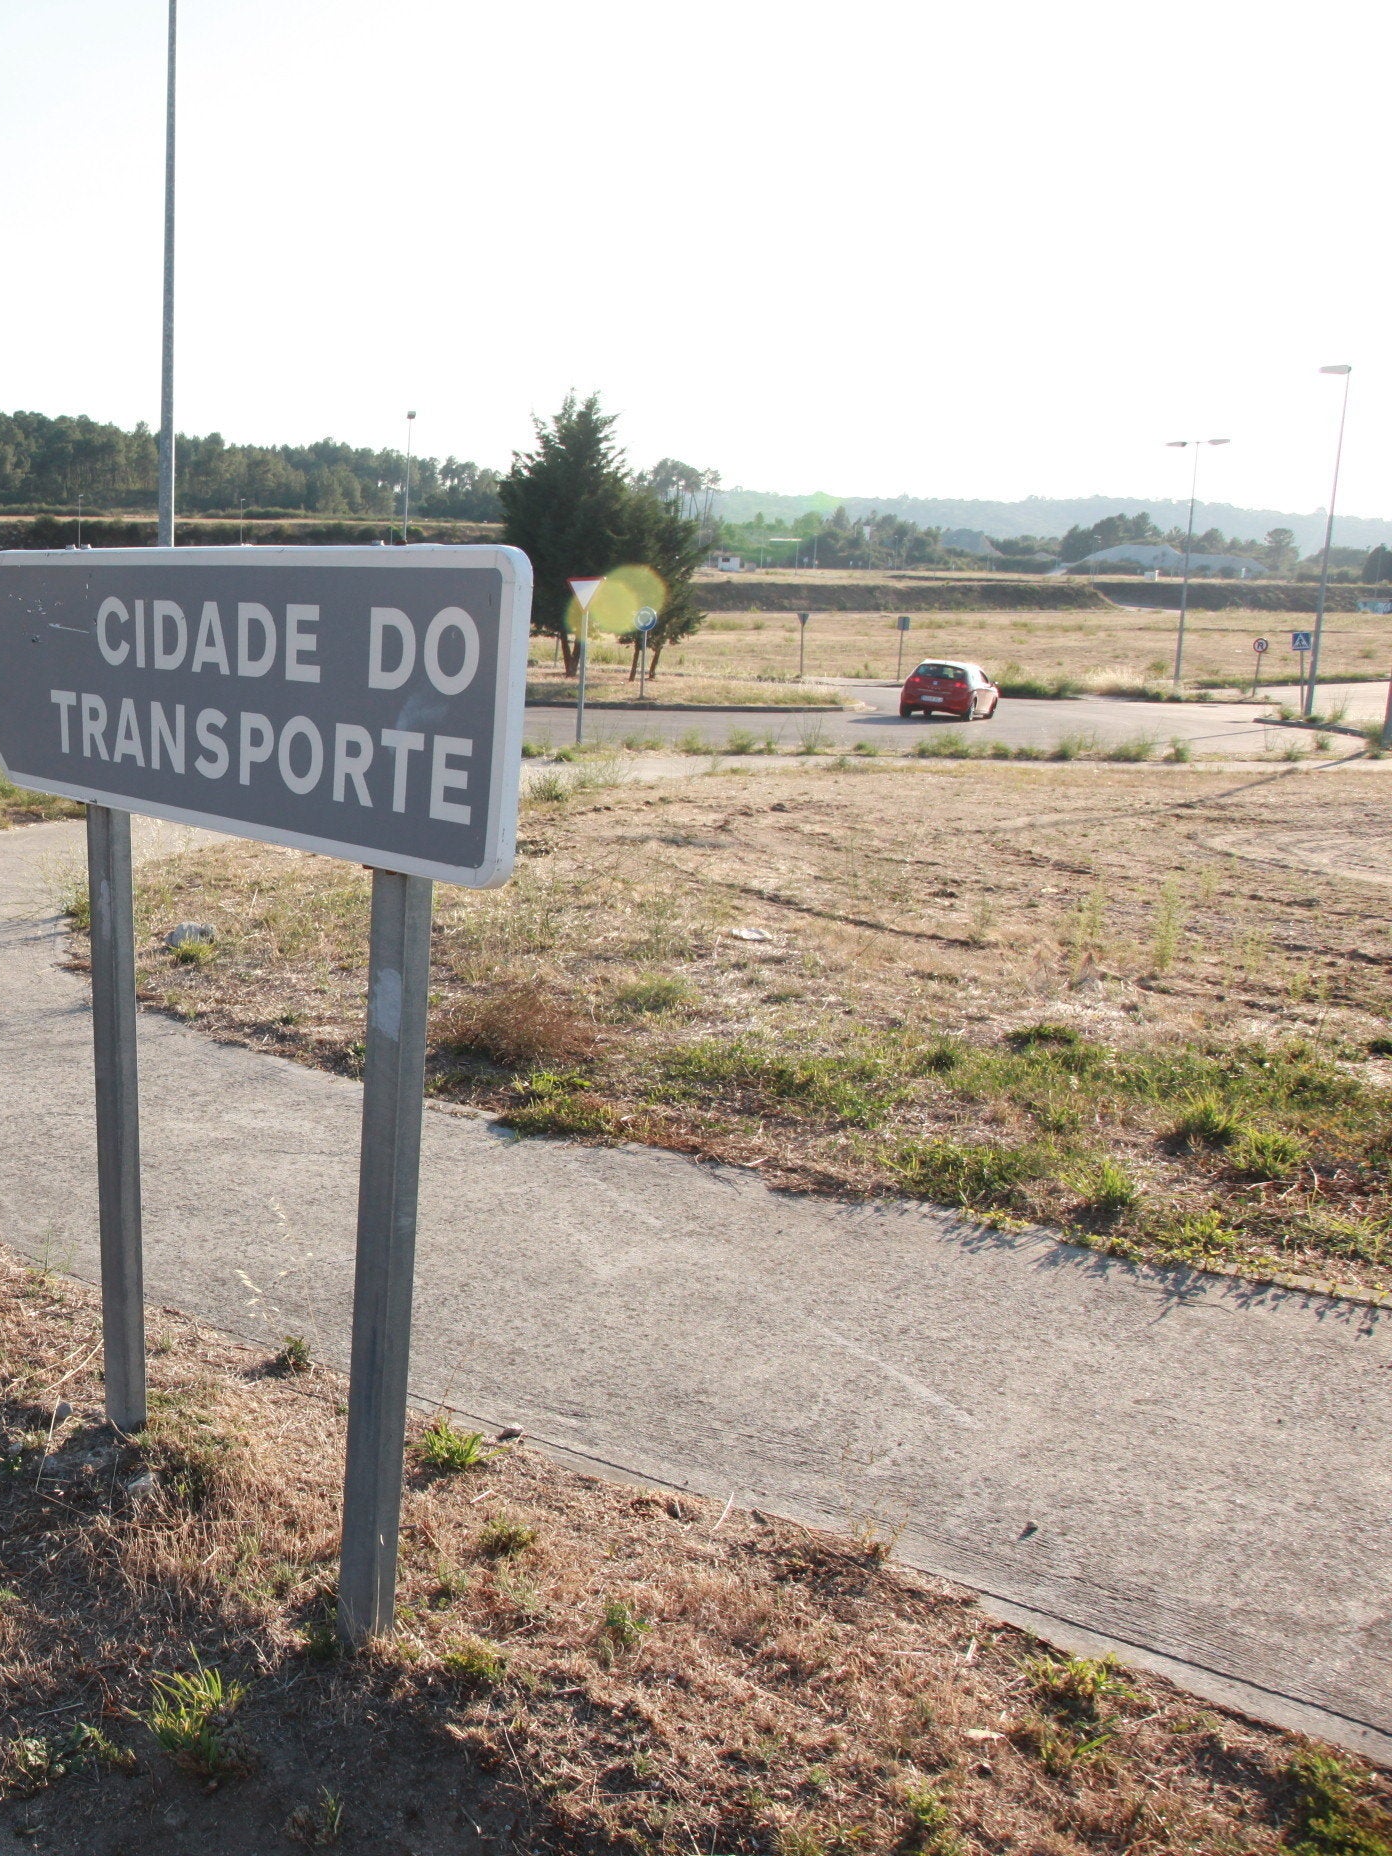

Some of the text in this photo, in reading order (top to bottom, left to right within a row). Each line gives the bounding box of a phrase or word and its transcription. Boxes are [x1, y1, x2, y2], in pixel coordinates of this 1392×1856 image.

[96, 596, 480, 696] CIDADE DO
[50, 689, 473, 826] TRANSPORTE
